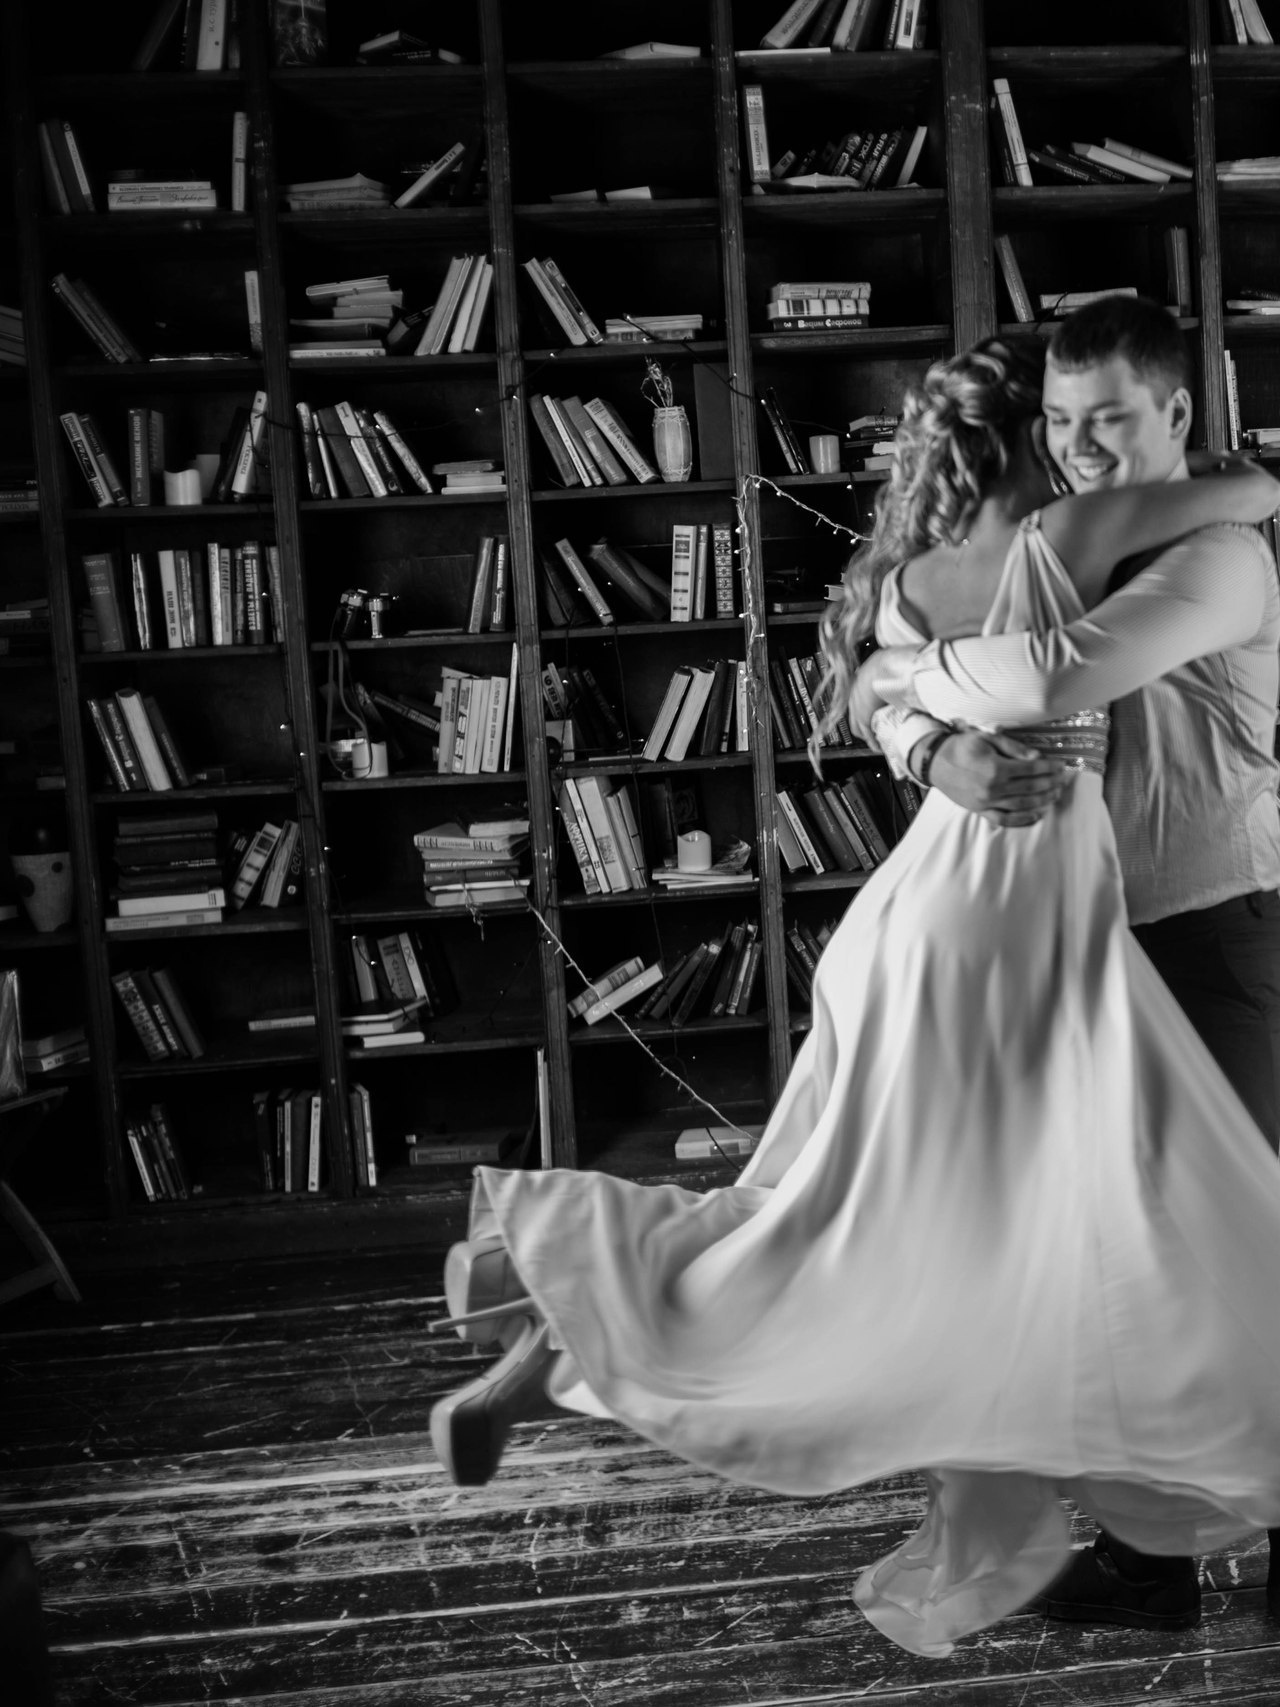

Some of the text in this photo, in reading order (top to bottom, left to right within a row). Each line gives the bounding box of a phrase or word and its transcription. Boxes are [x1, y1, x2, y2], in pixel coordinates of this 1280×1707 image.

[859, 139, 873, 159] TDK
[244, 559, 253, 592] ПАДЕНИЯ
[247, 601, 256, 631] ВЗЛЕТЫ
[568, 822, 590, 861] АФРИКА
